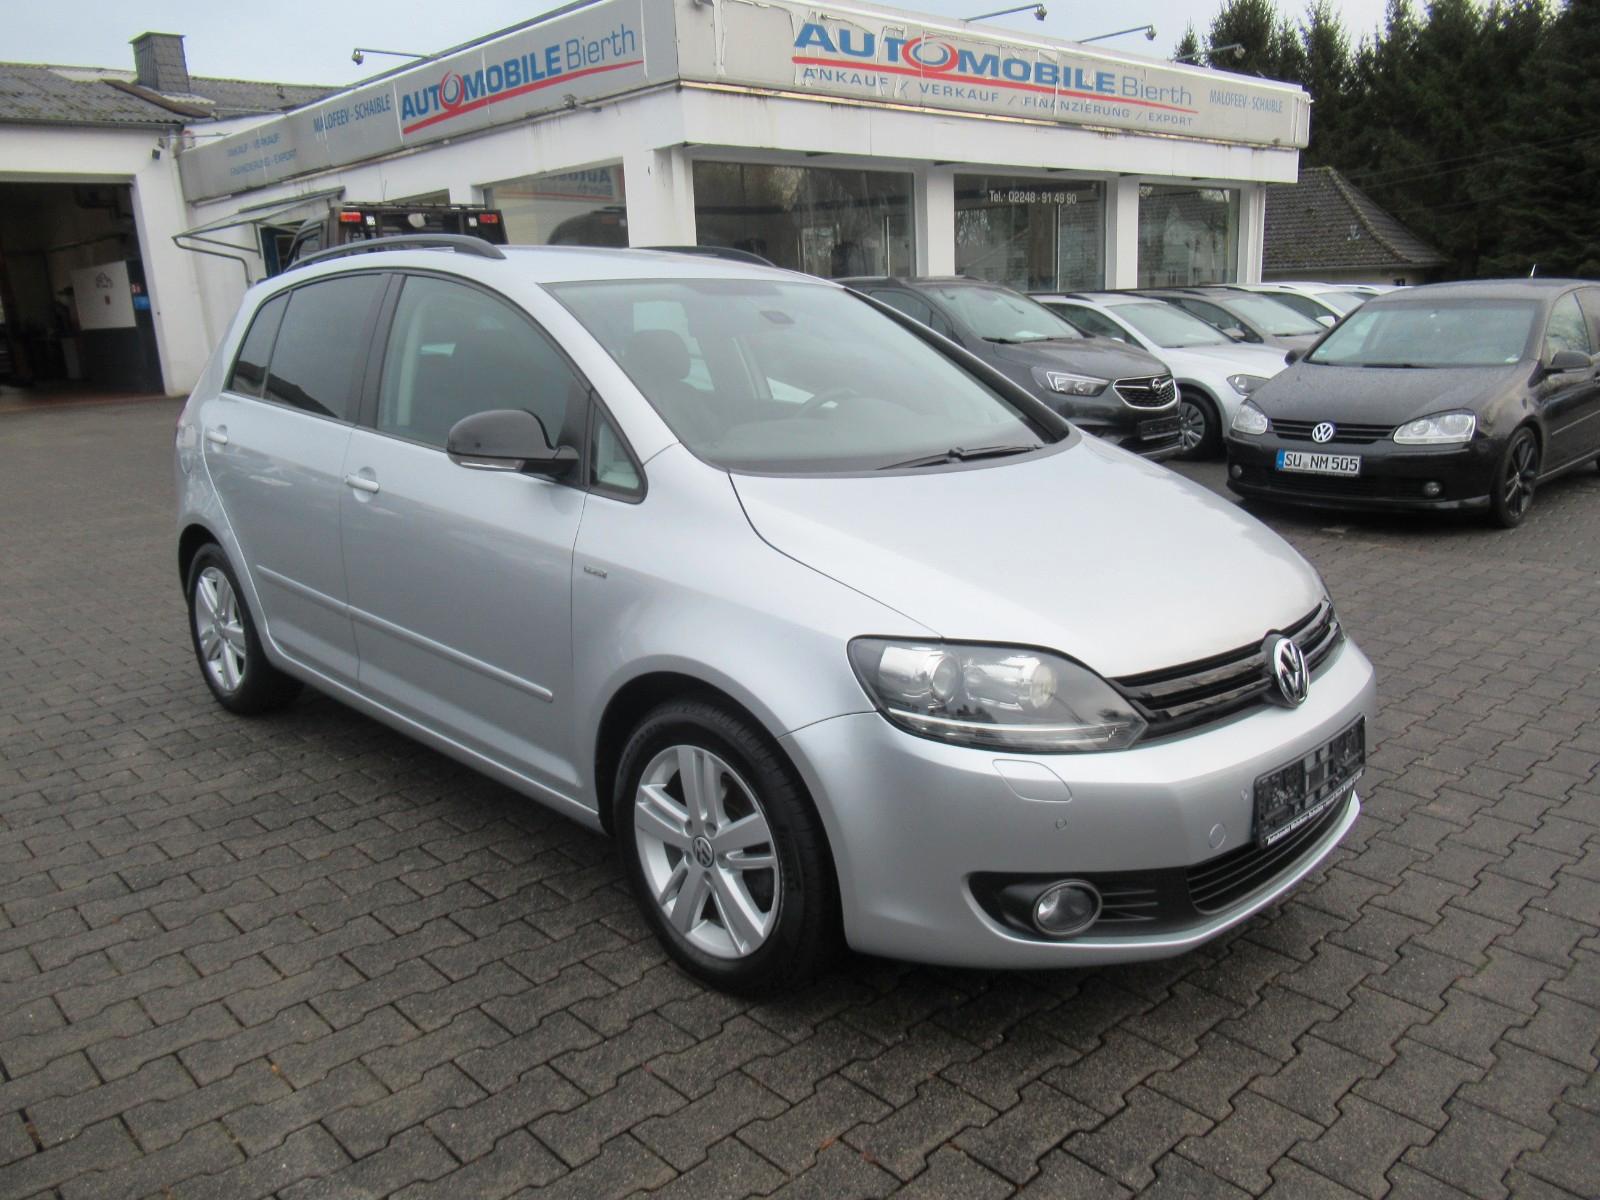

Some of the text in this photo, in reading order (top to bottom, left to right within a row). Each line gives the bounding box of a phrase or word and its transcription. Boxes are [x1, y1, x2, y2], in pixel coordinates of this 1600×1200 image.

[402, 23, 636, 120] AUTOMOBILE Bierth
[793, 22, 1193, 106] AUTOMOBILE Bierth
[313, 107, 350, 132] MALOFEEV
[354, 93, 391, 120] SCHAIBLE
[803, 67, 889, 88] ANKAUF
[919, 82, 1000, 102] VERKAUF
[1024, 96, 1130, 118] FINANZIERUNG
[1149, 112, 1193, 127] EXPORT
[1208, 89, 1248, 109] MALOFEEV
[1008, 191, 1036, 203] 02248
[1041, 191, 1052, 204] 91
[1053, 192, 1065, 204] 49
[1066, 192, 1077, 205] 90
[1284, 453, 1359, 472] SU NM 505
